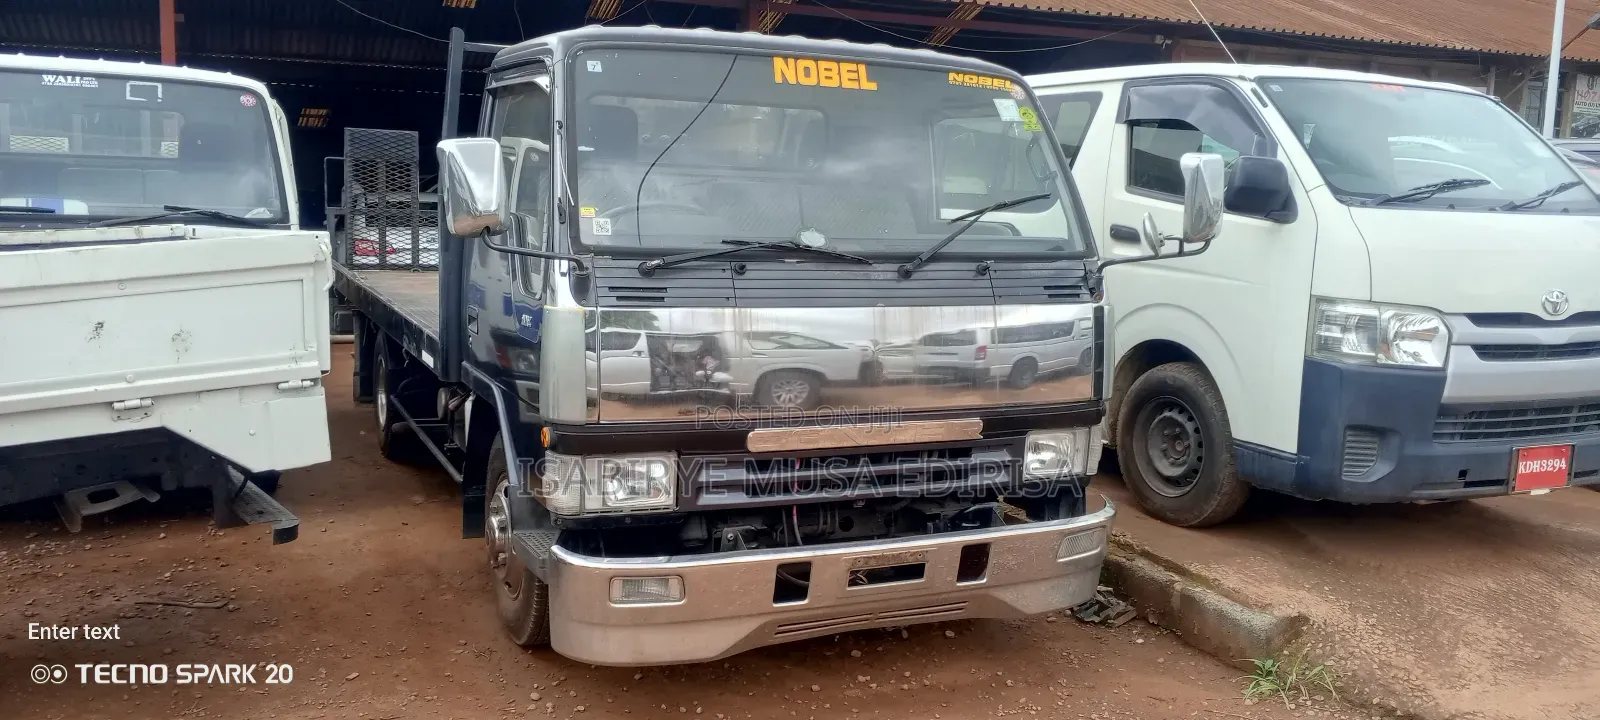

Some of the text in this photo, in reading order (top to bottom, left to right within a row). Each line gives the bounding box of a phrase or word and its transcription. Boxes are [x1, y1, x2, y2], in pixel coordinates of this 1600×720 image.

[41, 74, 82, 84] WALI
[773, 56, 878, 91] NOBEL
[948, 72, 1016, 91] NOBEL
[1518, 457, 1567, 474] KDH3294
